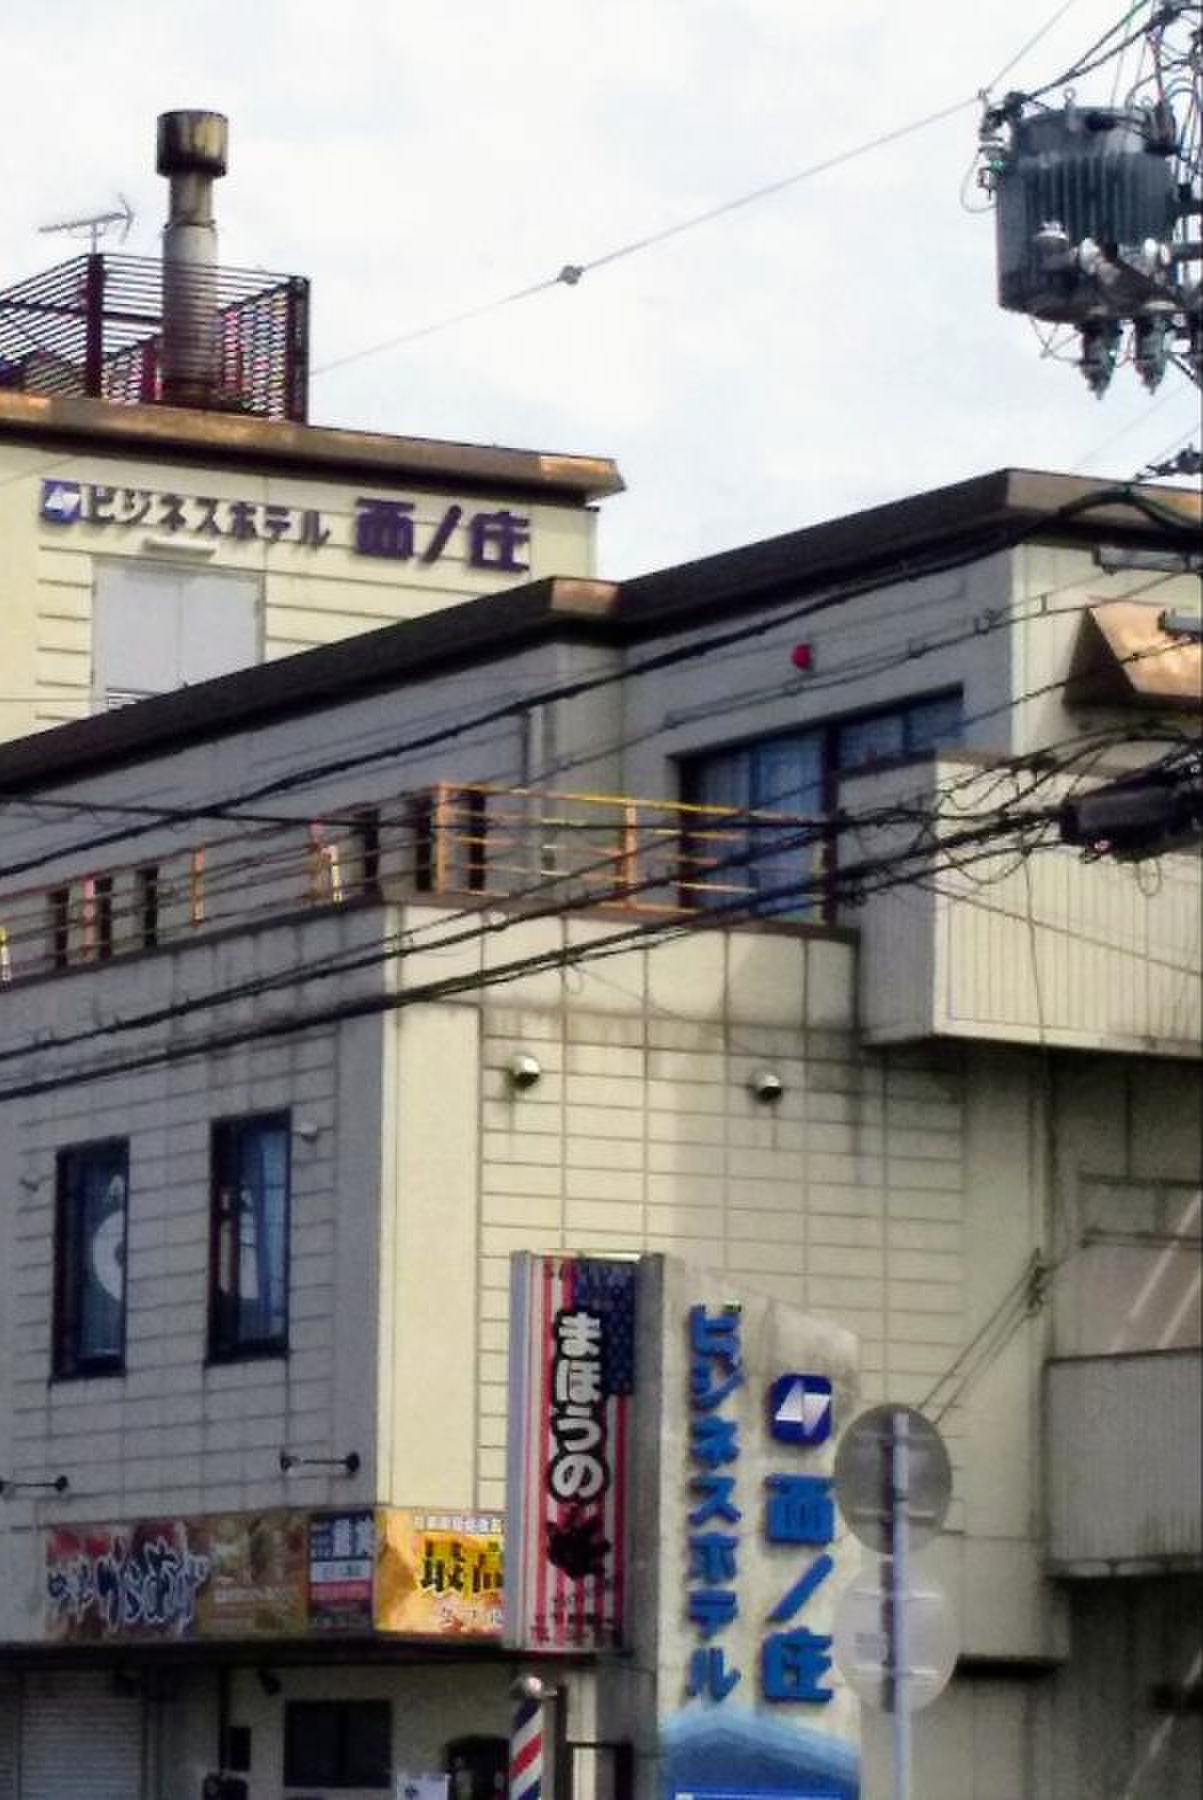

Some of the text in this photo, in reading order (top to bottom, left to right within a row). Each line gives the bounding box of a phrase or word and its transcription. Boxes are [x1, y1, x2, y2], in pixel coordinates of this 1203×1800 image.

[83, 485, 530, 572] ビジネスホテル 西ノ庄
[547, 1308, 610, 1580] まほうの
[687, 1305, 743, 1699] ビジネスホテル
[763, 1474, 835, 1702] 西ノ庄
